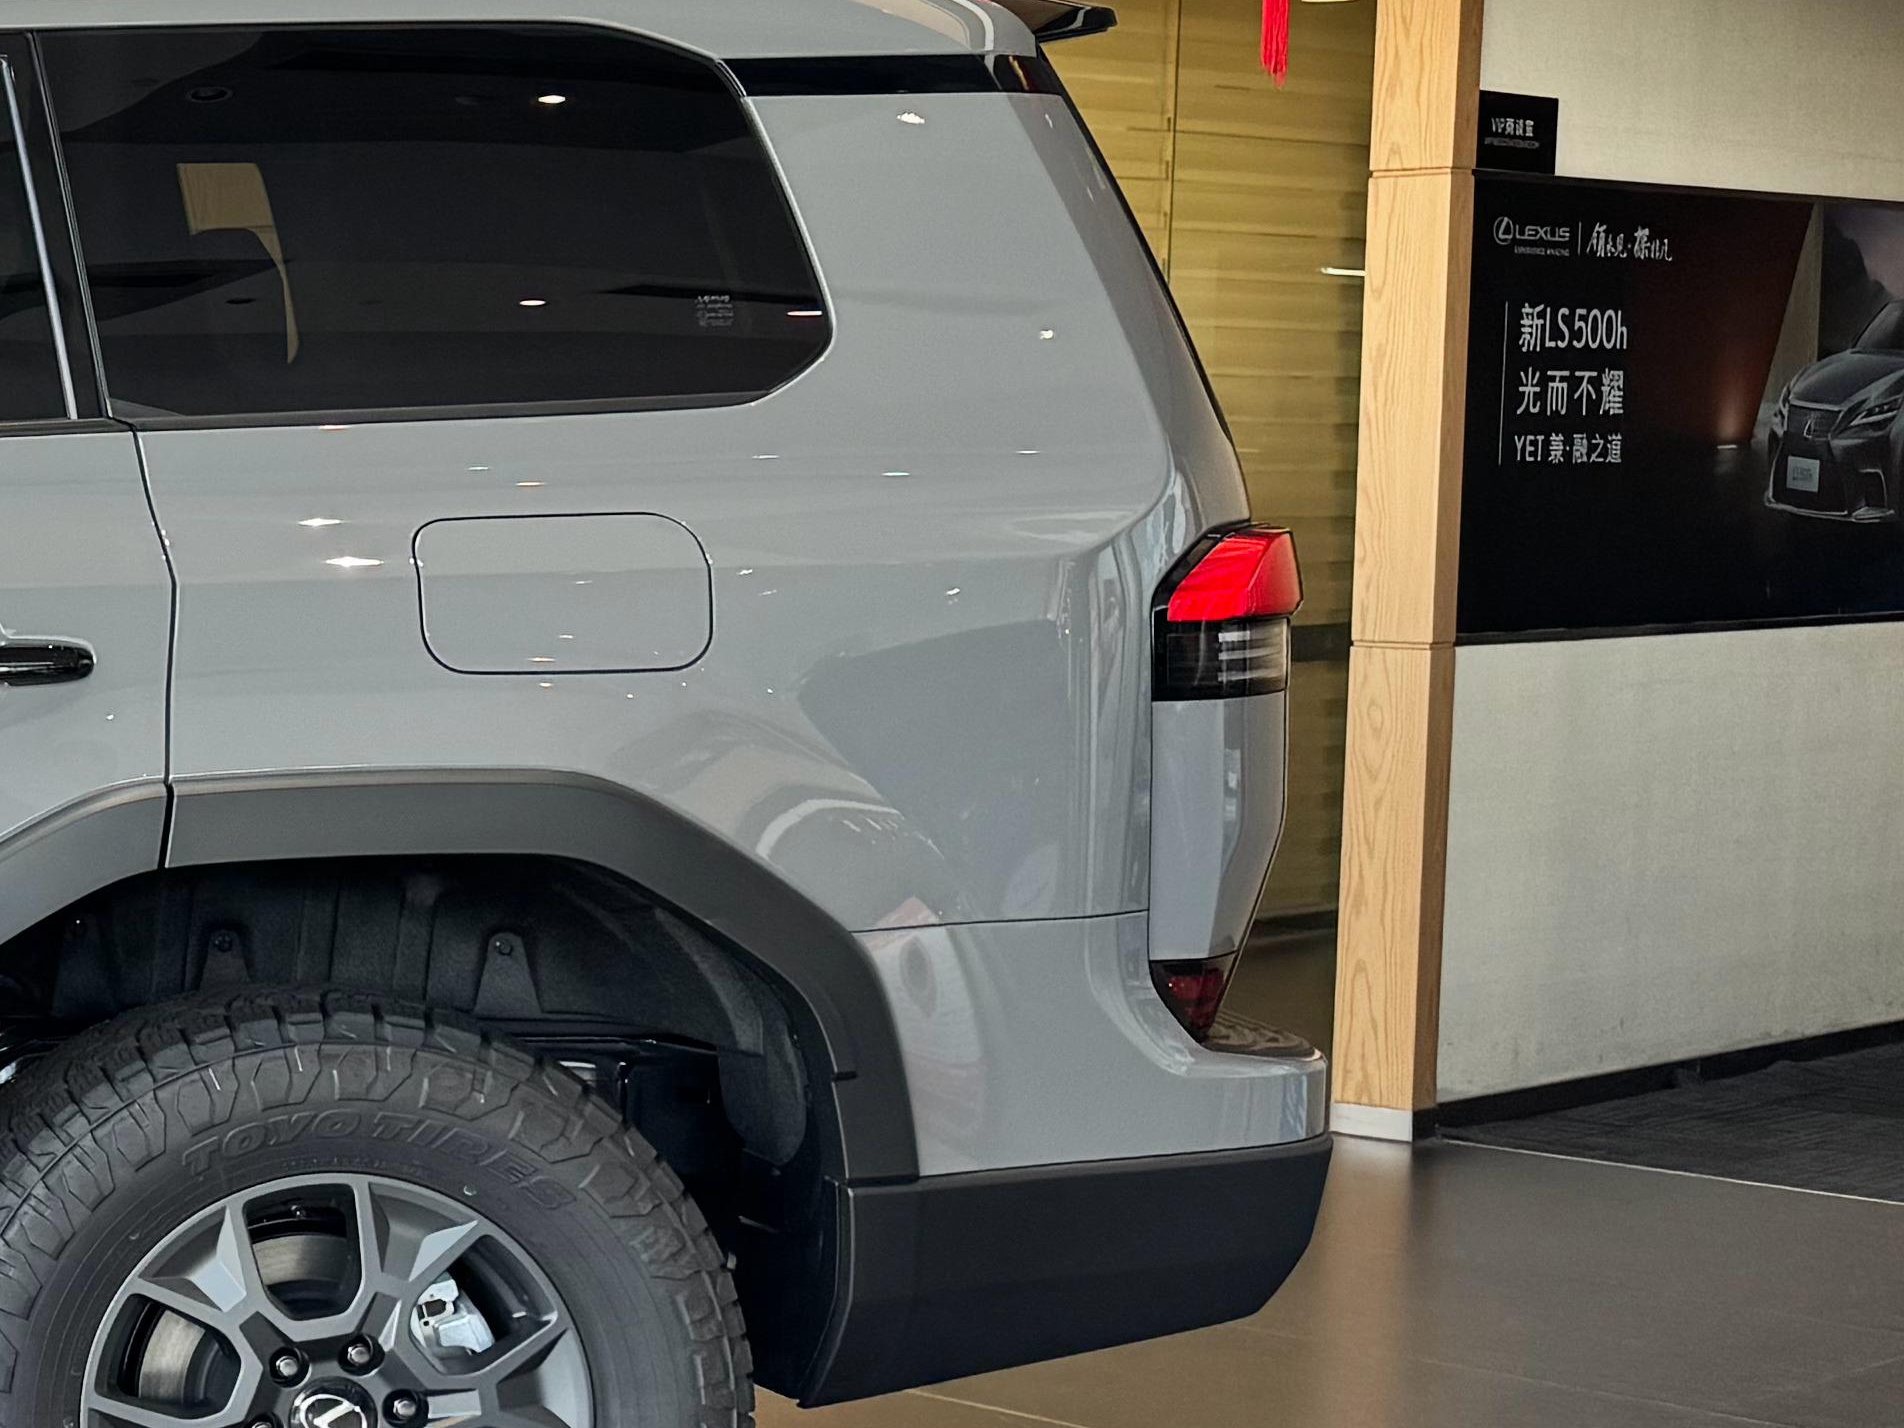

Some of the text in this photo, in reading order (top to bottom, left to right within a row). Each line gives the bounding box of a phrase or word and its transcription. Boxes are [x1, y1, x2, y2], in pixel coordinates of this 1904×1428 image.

[1516, 225, 1570, 242] LEXUS
[1517, 367, 1624, 415] 光而不耀
[1514, 434, 1545, 463] YET
[181, 1109, 578, 1210] TOYO TIRES
